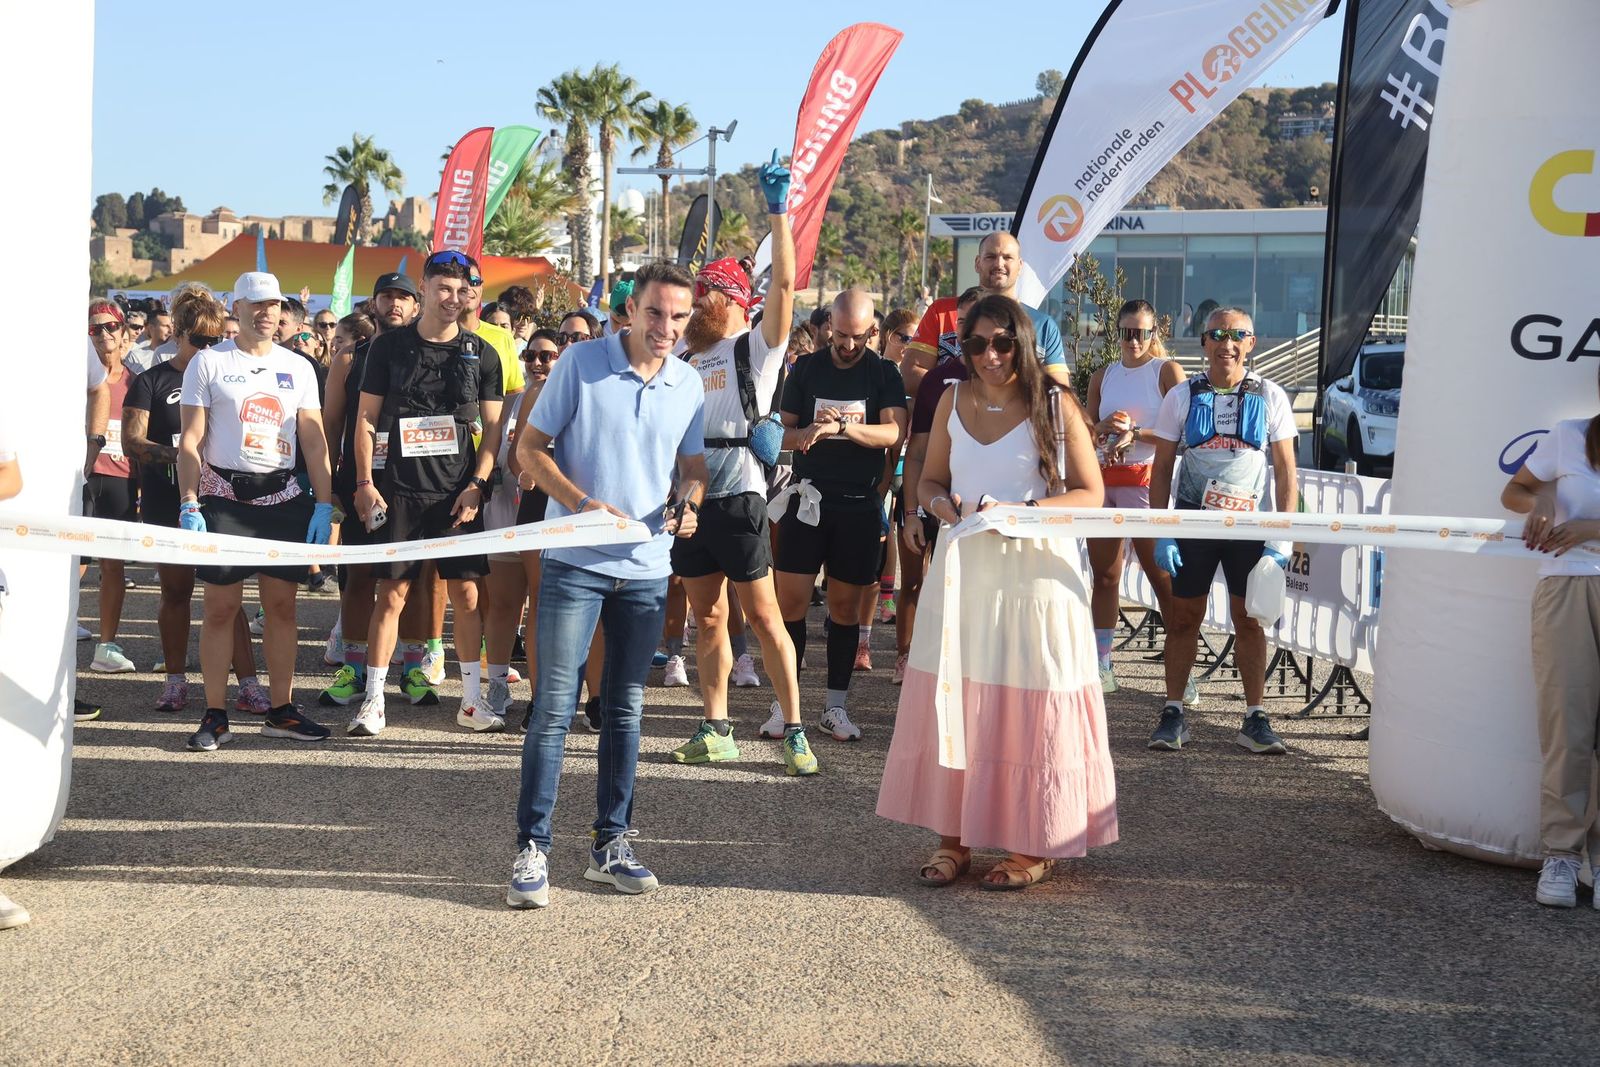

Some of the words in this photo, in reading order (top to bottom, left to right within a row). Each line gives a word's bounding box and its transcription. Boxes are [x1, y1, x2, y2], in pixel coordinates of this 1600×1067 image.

[1169, 0, 1319, 114] PLOGGIN
[1380, 0, 1449, 131] #B
[1074, 128, 1133, 190] nationale
[1086, 120, 1165, 202] nederlanden
[973, 217, 999, 231] IGY
[1103, 216, 1144, 230] RINA
[248, 402, 282, 421] PONLE
[407, 428, 451, 442] 24937
[1209, 494, 1251, 511] 24374
[1286, 576, 1309, 592] Balears
